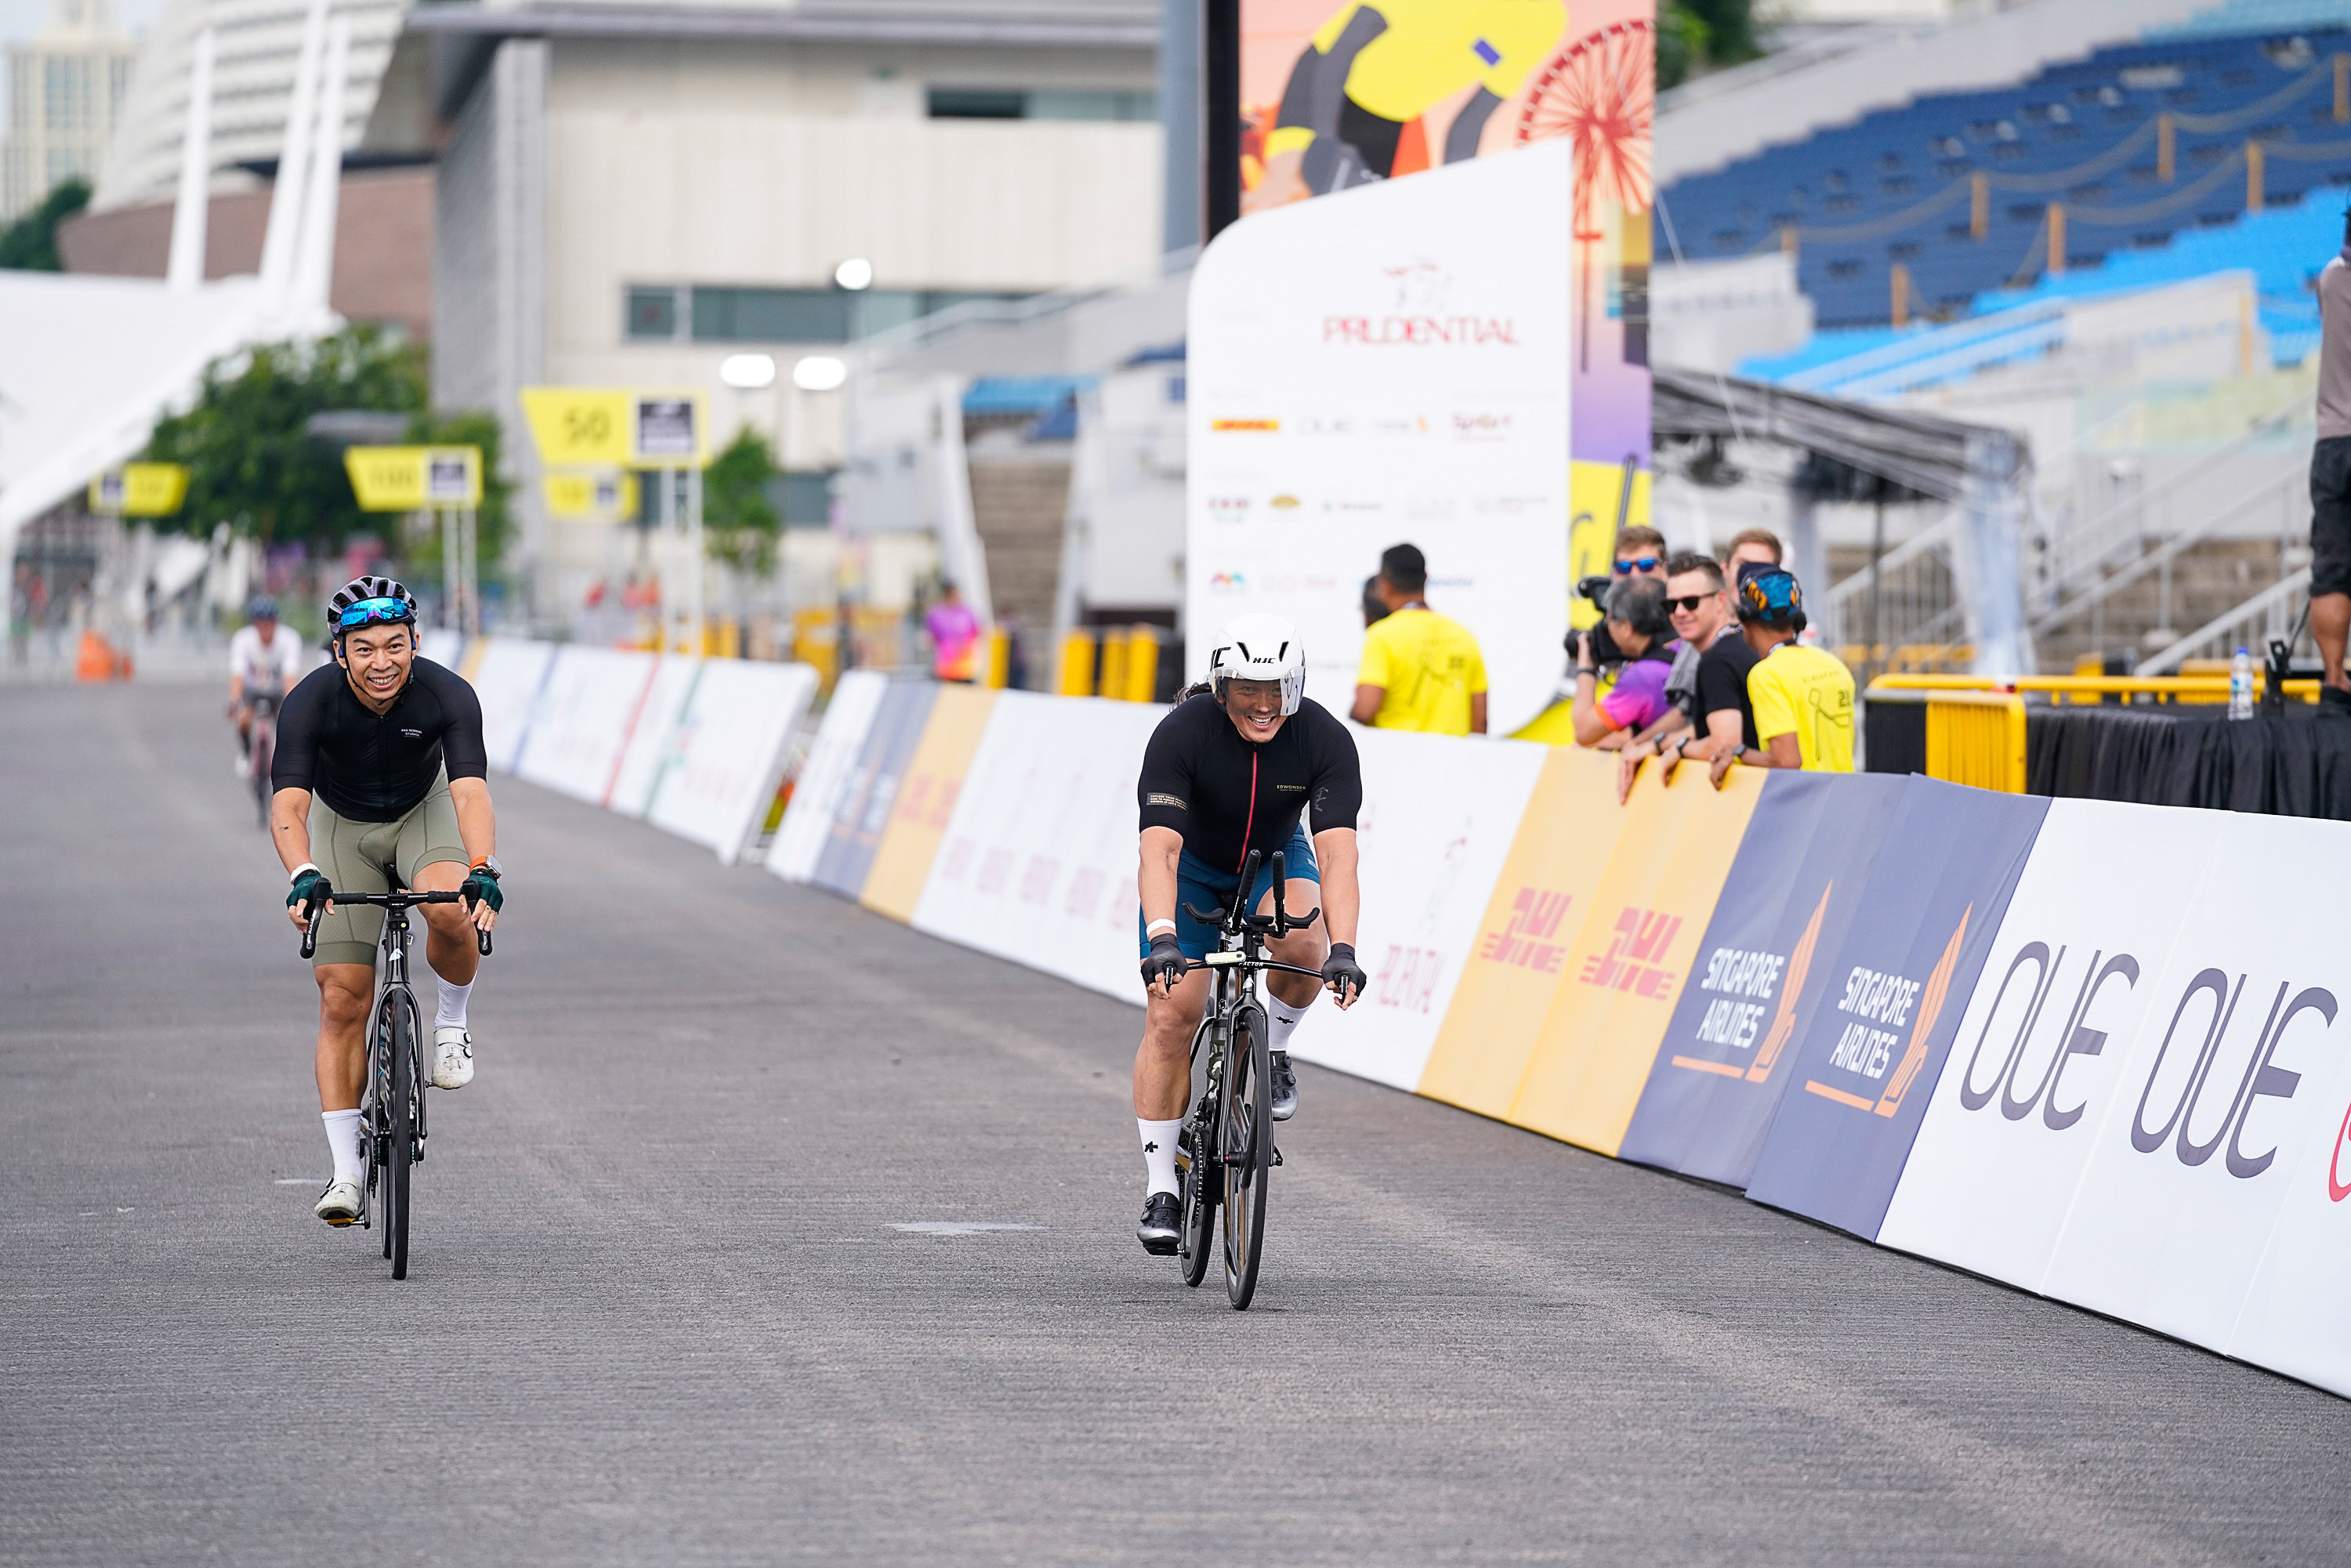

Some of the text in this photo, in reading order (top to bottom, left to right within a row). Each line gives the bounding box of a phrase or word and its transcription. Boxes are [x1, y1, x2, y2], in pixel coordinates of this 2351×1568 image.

[1323, 315, 1521, 345] PRUDENTIAL
[1701, 947, 1785, 999] SINGAPORE
[1837, 965, 1921, 1027] SINGAPORE
[1695, 998, 1766, 1048] AIRLINES
[1828, 1022, 1899, 1079] AIRLINES
[1960, 941, 2140, 1131] OUE
[2130, 968, 2338, 1179] OUE
